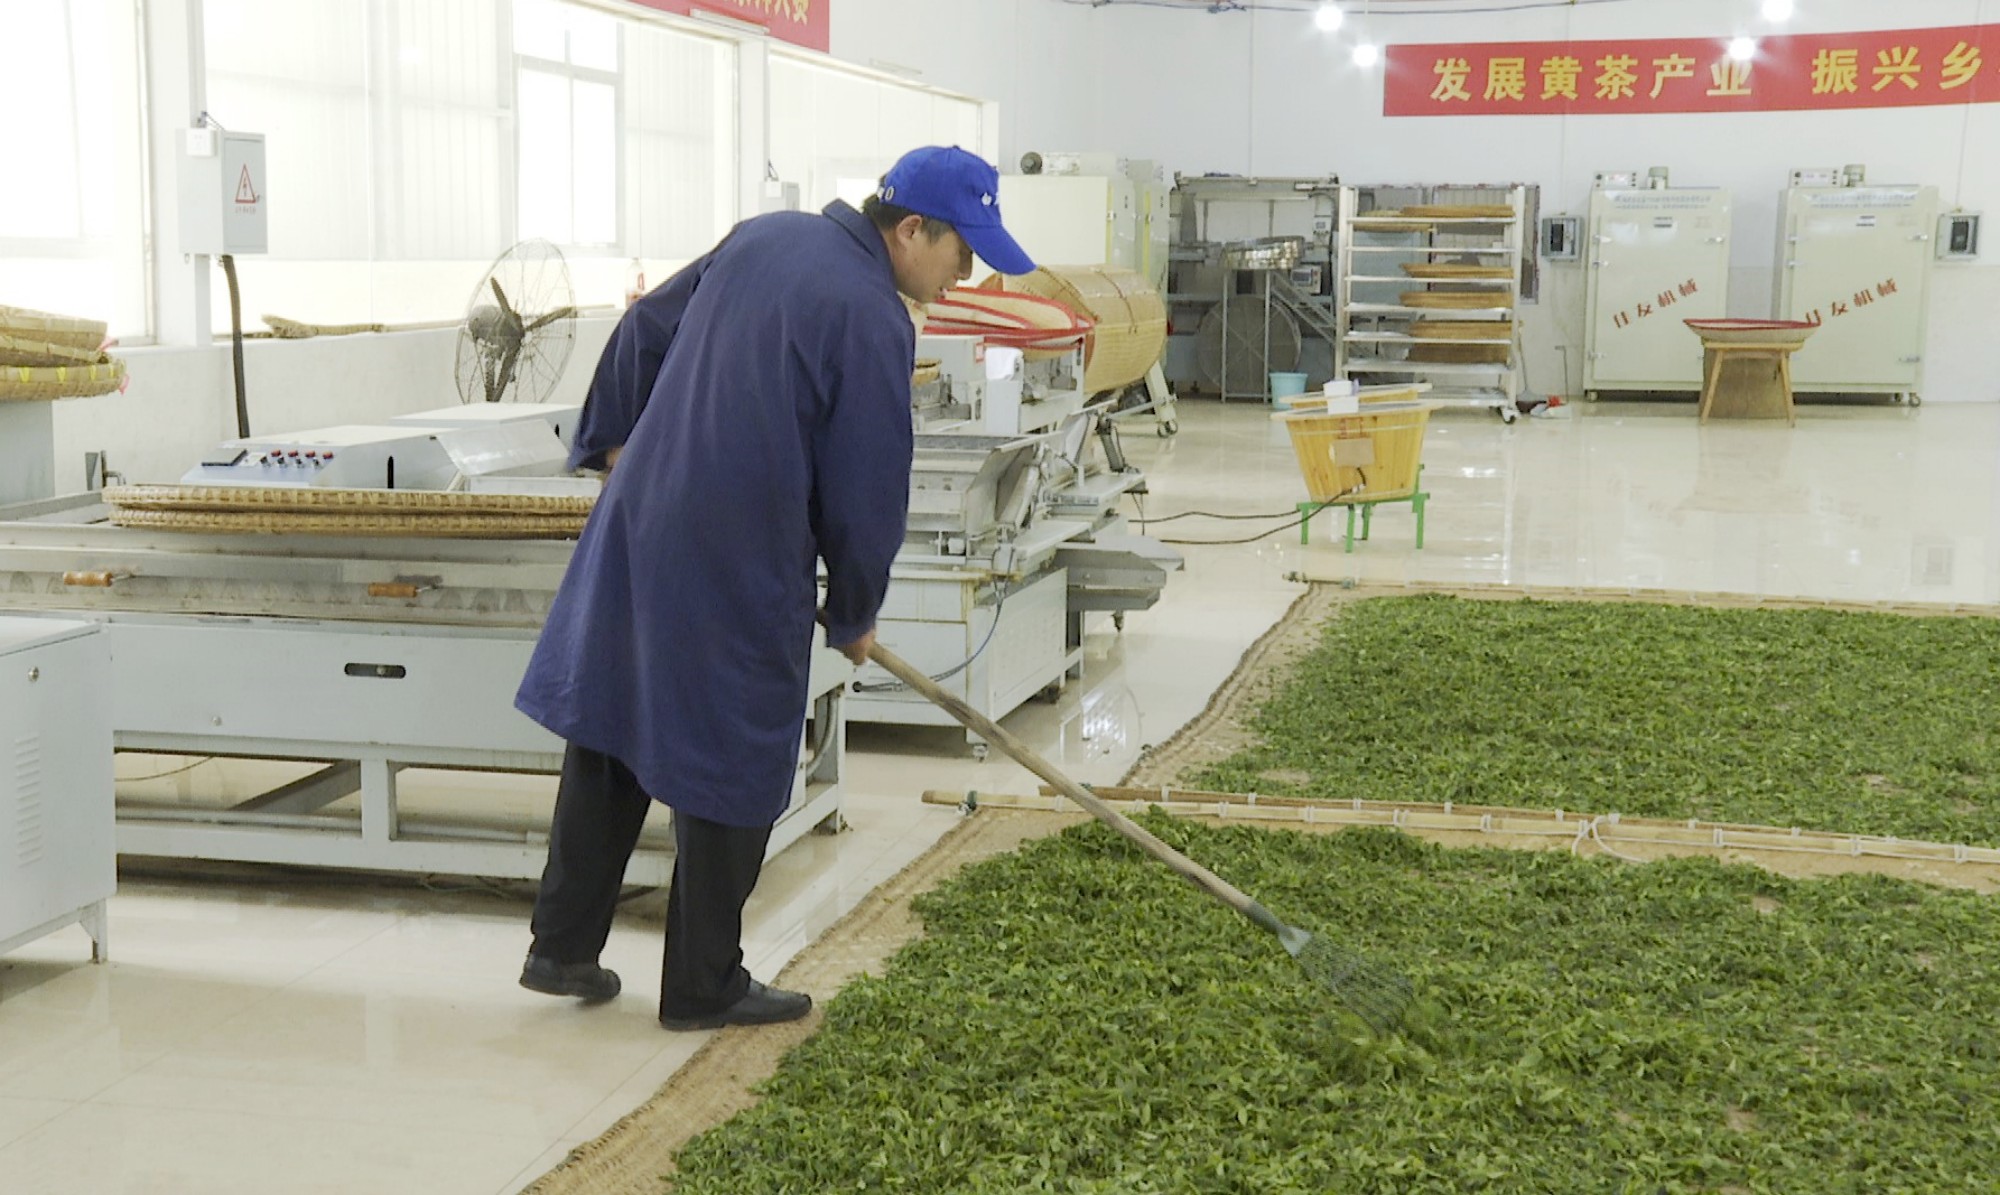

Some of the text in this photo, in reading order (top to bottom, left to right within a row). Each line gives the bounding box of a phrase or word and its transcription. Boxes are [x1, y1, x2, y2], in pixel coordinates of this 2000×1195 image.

[1430, 41, 1983, 102] 发展黄茶产业 振兴乡
